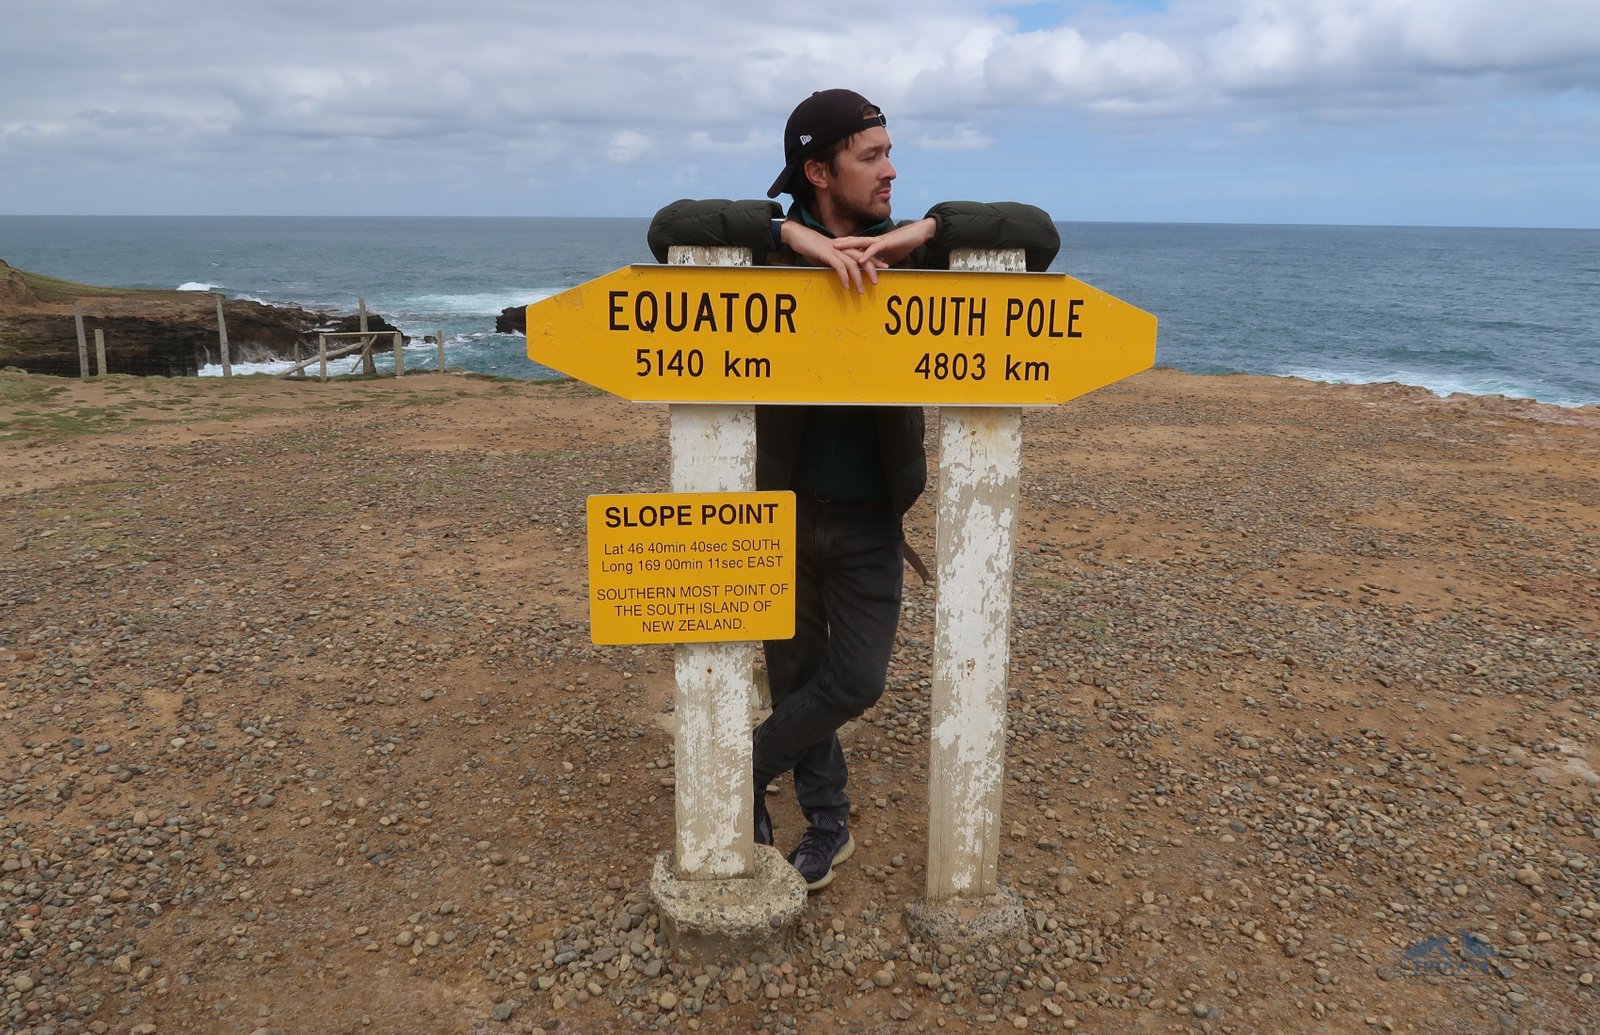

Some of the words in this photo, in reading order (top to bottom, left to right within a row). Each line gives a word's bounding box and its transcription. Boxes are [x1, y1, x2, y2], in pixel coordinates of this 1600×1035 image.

[608, 290, 797, 334] EQUATOR
[884, 294, 987, 337] SOUTH
[1005, 297, 1084, 338] POLE
[636, 348, 704, 378] 5140
[724, 350, 771, 378] km
[914, 352, 986, 381] 4803
[1005, 354, 1050, 382] km
[605, 504, 693, 529] SLOPE
[701, 503, 779, 526] POINT
[604, 543, 624, 555] Lat
[627, 542, 644, 554] 46
[647, 541, 686, 554] 40min
[690, 540, 728, 553] 40sec
[731, 538, 780, 552] SOUTH
[601, 560, 633, 575] Long
[638, 559, 661, 571] 169
[664, 558, 703, 571] 00min
[708, 557, 743, 570] 11sec
[747, 555, 784, 568] EAST
[597, 586, 676, 601] SOUTHERN
[680, 585, 720, 598] MOST
[724, 583, 766, 597] POINT
[769, 583, 789, 596] OF
[614, 604, 642, 617] THE
[646, 603, 695, 616] SOUTH
[699, 601, 749, 614] ISLAND
[753, 600, 772, 613] OF
[642, 620, 675, 633] NEW
[678, 618, 746, 632] ZEALAND.
